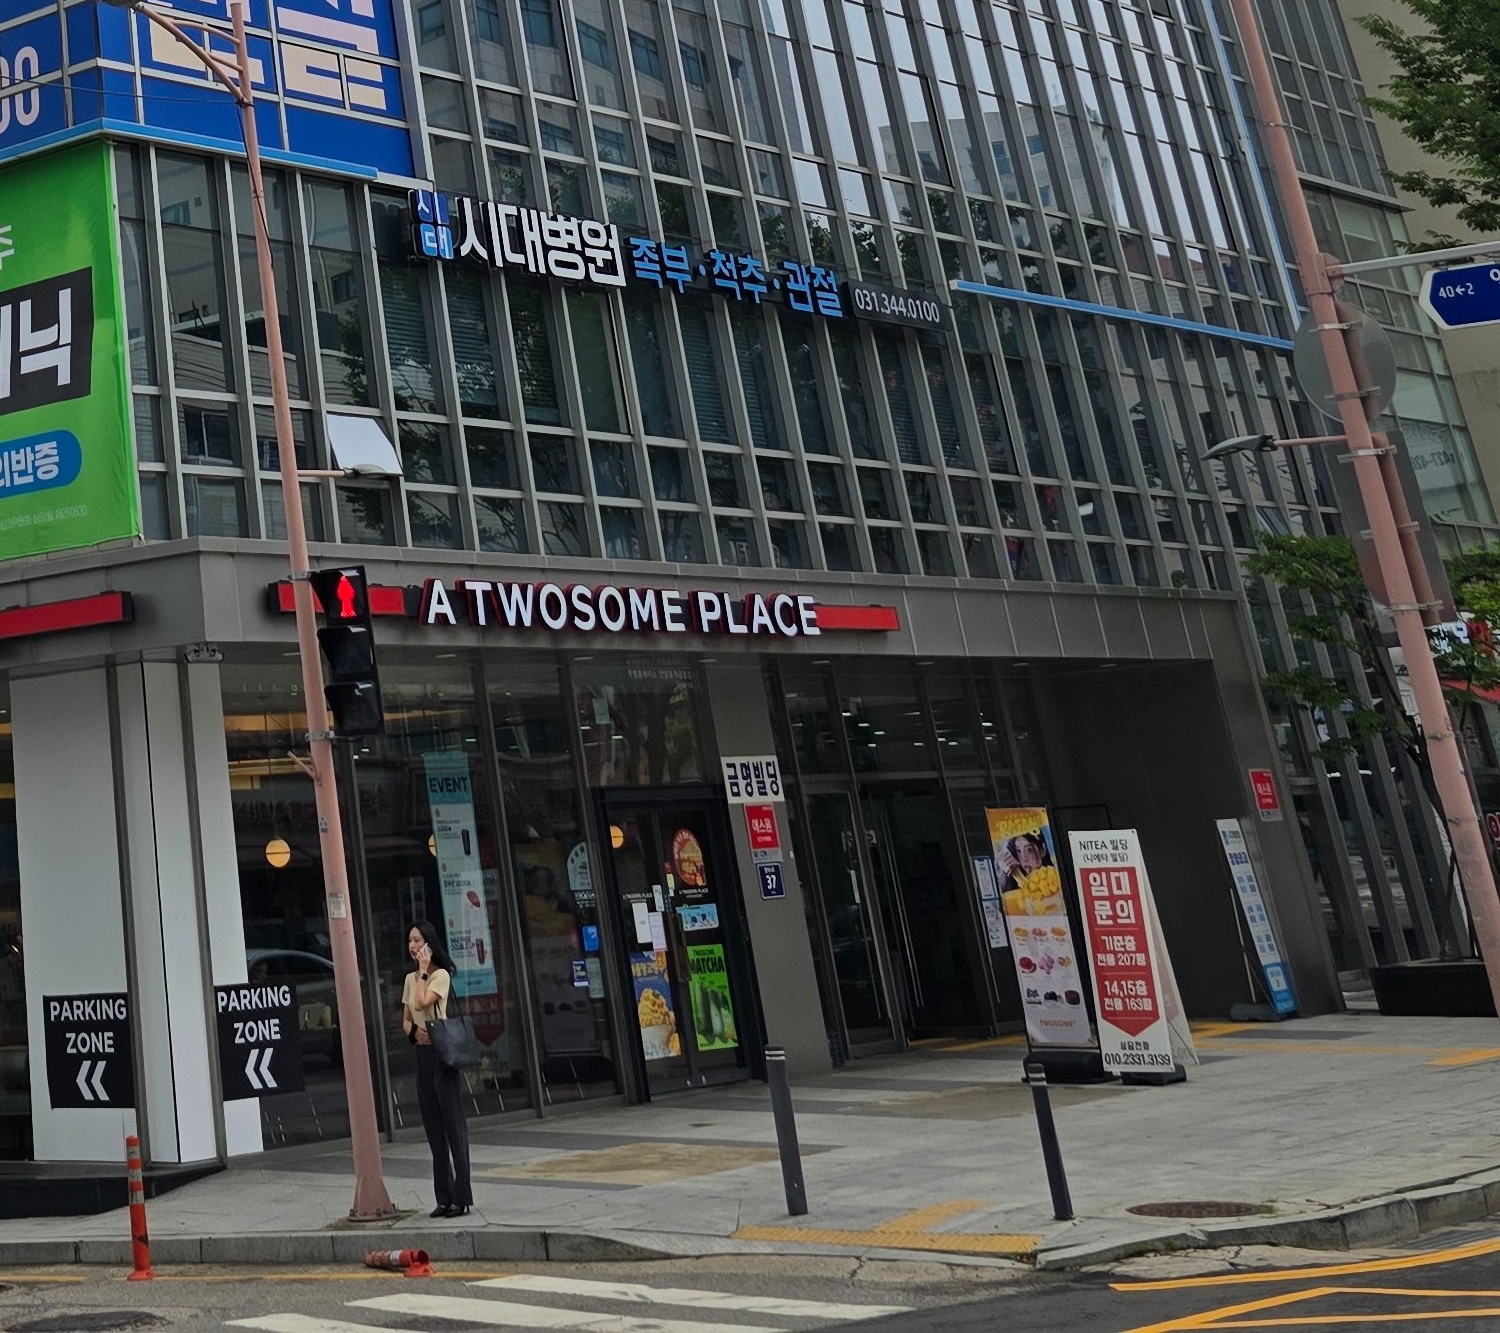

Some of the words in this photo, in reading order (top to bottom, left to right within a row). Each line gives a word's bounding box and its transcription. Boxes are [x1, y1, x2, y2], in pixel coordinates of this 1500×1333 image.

[461, 197, 627, 288] 시대병원
[630, 236, 693, 294] 족부
[710, 248, 769, 304] 척추
[783, 260, 844, 318] 관절
[855, 287, 941, 324] 031.344.0100
[1438, 285, 1455, 299] 40
[426, 579, 457, 625] A
[464, 580, 685, 632] TWOSOME
[699, 591, 821, 636] PLACE
[428, 774, 469, 795] EVENT
[765, 874, 777, 889] 37
[1088, 871, 1132, 897] 임대
[1093, 899, 1136, 925] 문의
[1100, 935, 1137, 951] 기준층
[49, 997, 127, 1022] PARKING
[217, 984, 292, 1013] PARKING
[66, 1031, 115, 1055] ZONE
[233, 1019, 281, 1044] ZONE
